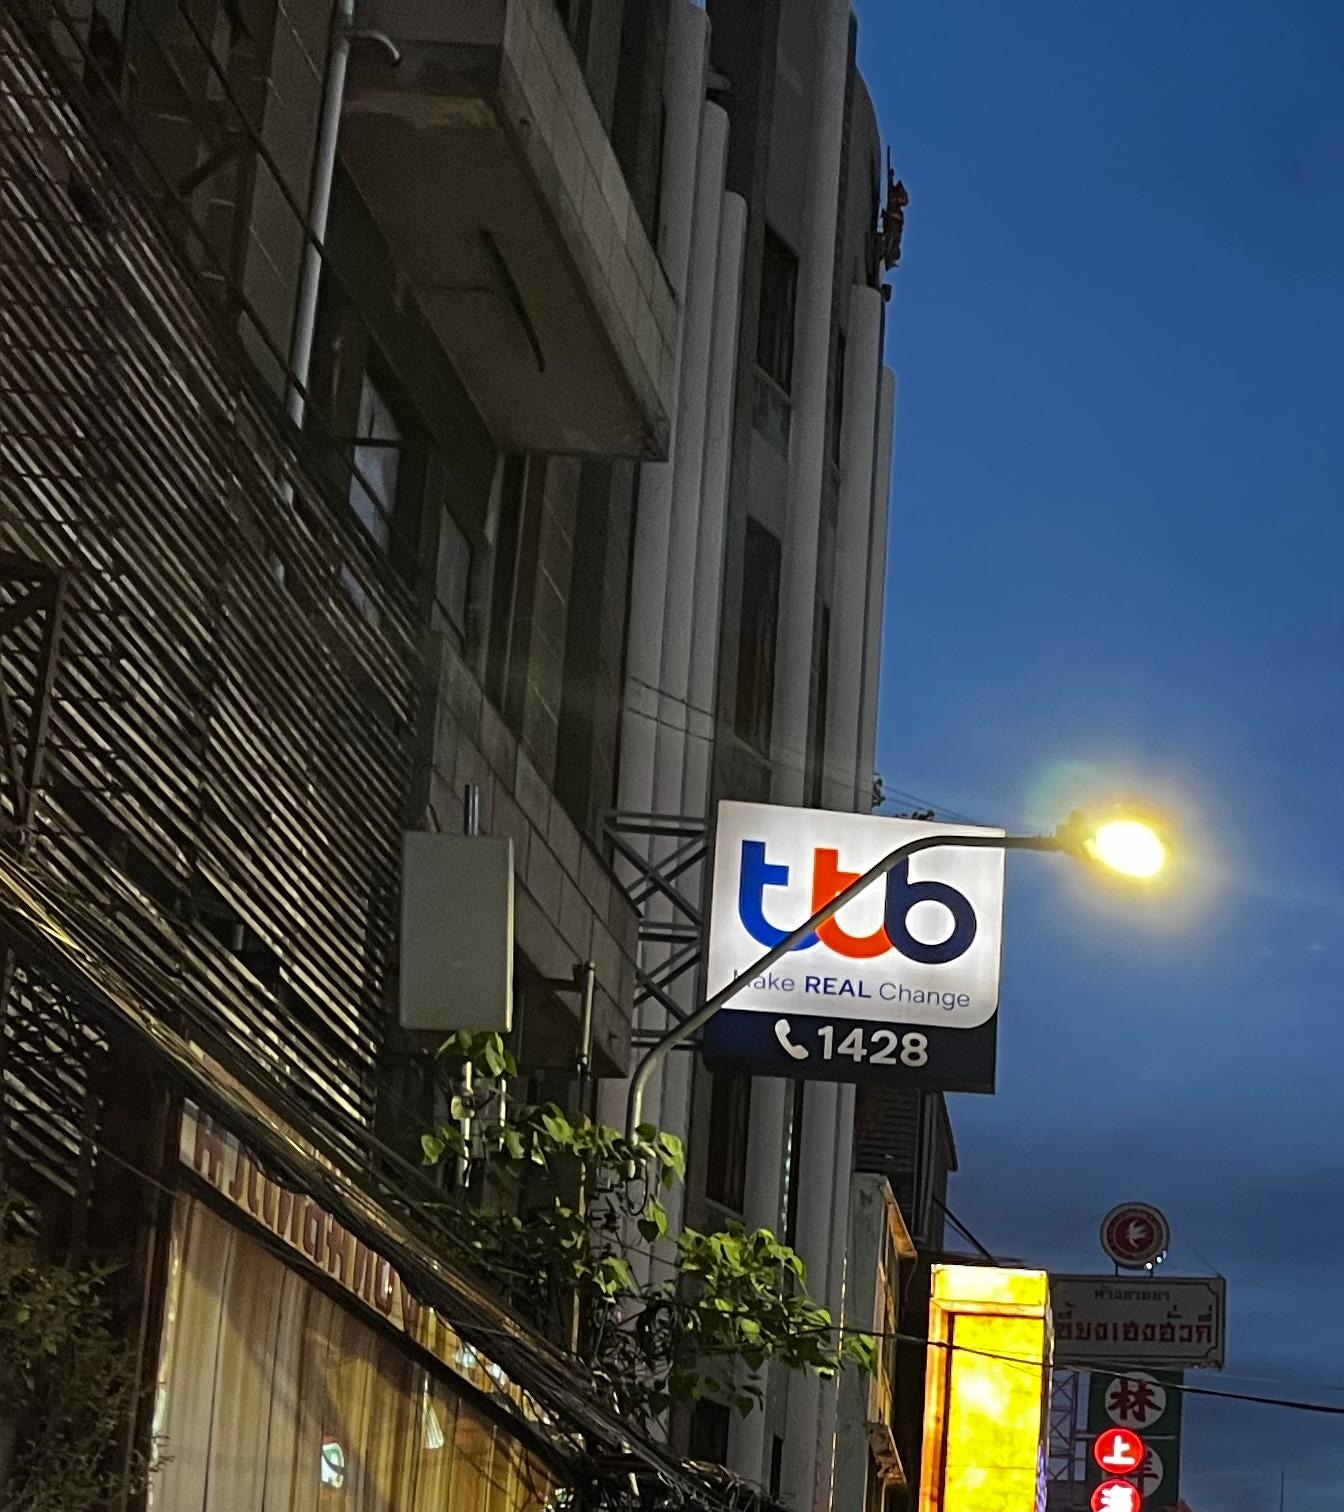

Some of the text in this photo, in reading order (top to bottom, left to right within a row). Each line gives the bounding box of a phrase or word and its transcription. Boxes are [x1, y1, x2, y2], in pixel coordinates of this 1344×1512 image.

[738, 839, 977, 965] ttb
[805, 974, 872, 1000] REAL
[878, 981, 971, 1011] Change
[816, 1024, 929, 1069] 1428
